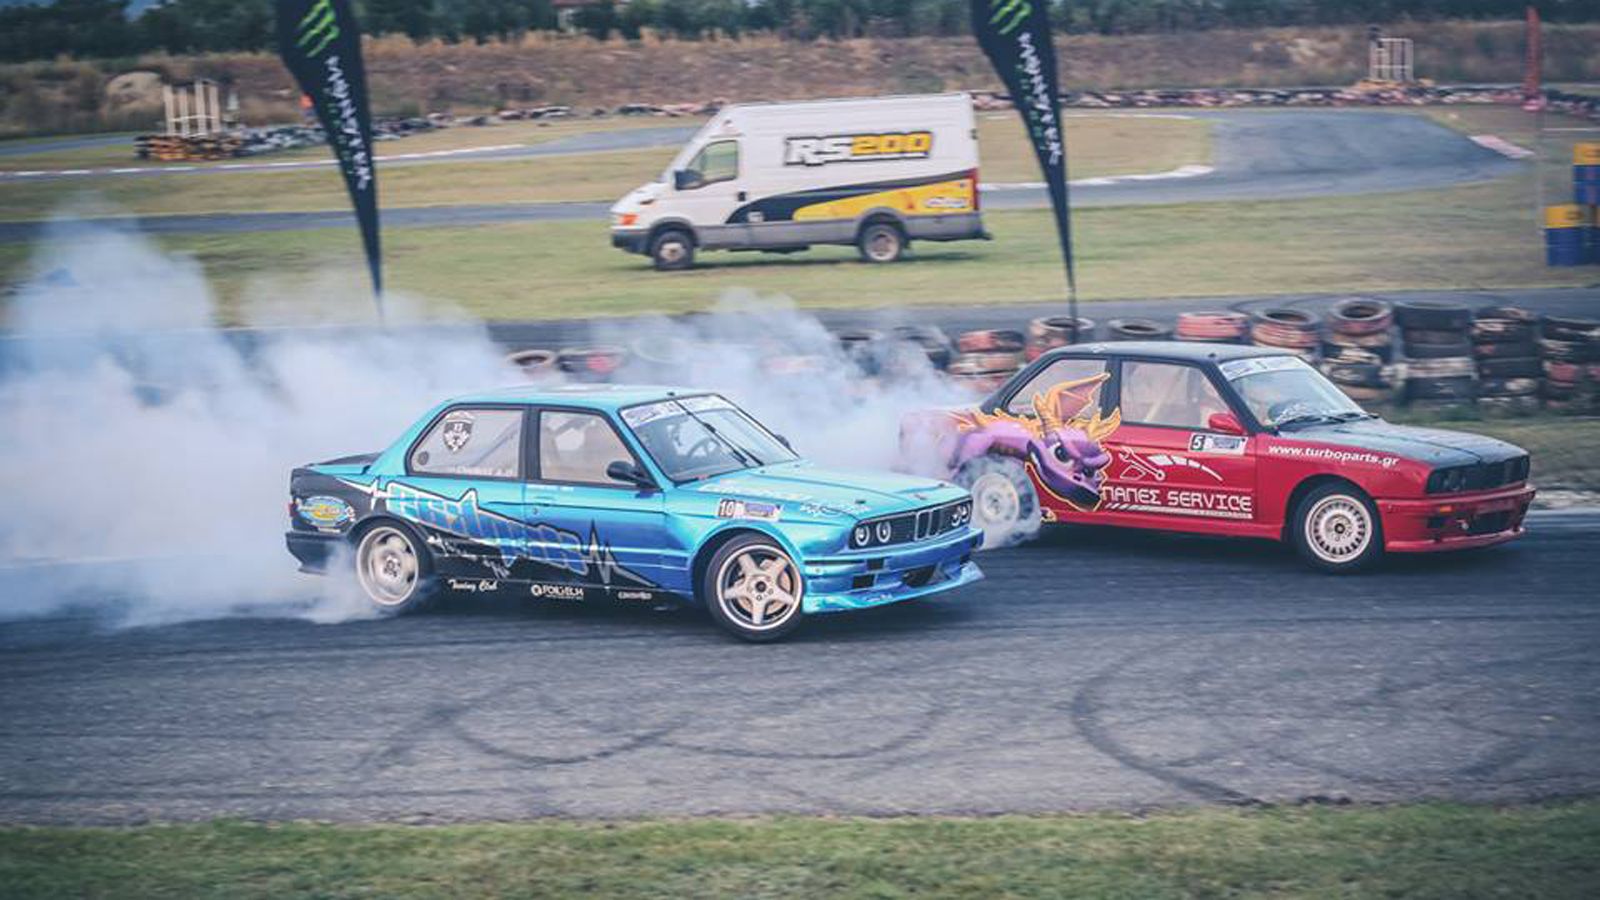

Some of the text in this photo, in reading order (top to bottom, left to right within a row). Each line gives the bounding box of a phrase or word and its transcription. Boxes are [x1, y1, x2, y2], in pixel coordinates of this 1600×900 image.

[784, 130, 933, 166] RS200
[1192, 434, 1204, 450] 5
[1268, 445, 1400, 468] www.turboparts.gr
[719, 499, 734, 516] 10
[1167, 490, 1253, 512] SERVICE
